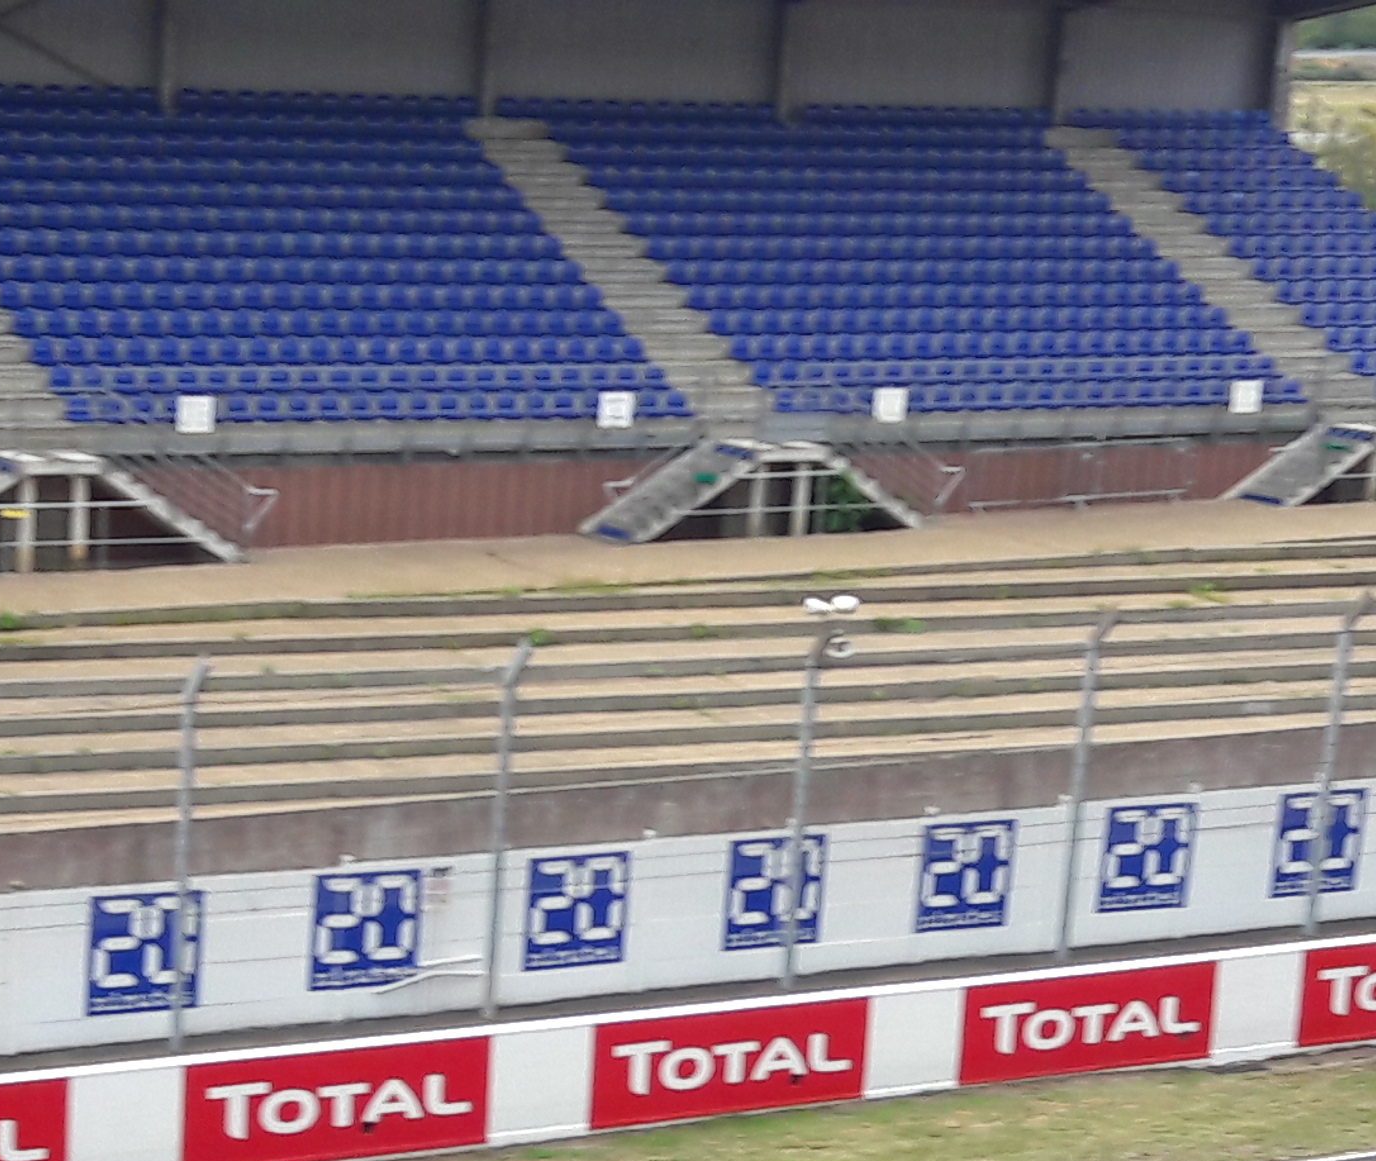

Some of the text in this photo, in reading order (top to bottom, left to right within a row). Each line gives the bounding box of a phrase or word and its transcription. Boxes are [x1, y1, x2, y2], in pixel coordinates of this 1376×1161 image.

[924, 825, 1011, 908] 20
[1105, 807, 1193, 889] 20
[315, 874, 417, 964] 20
[531, 856, 625, 945] 20
